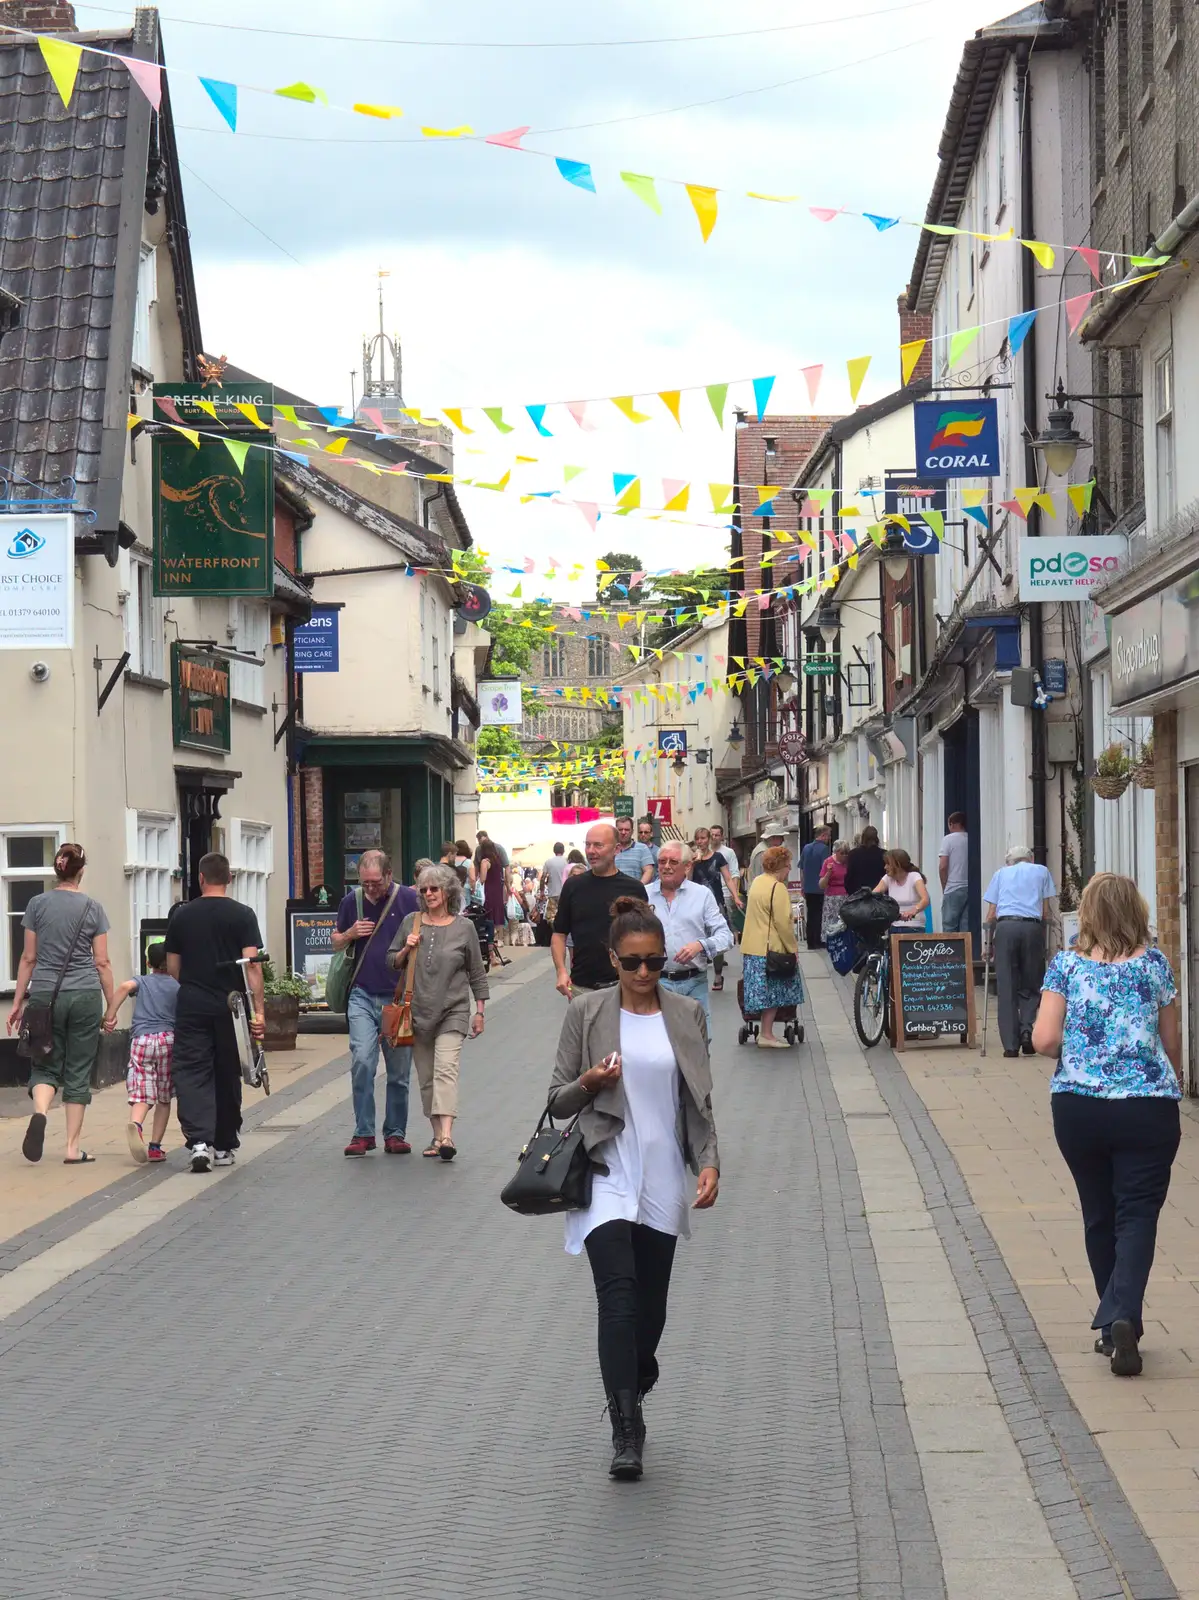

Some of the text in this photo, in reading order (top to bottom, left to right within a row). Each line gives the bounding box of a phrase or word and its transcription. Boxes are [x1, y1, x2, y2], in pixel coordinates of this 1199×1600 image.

[225, 395, 264, 406] KING
[925, 454, 990, 469] CORAL
[897, 497, 935, 513] HILL
[163, 557, 260, 569] WATERFRONT
[164, 572, 192, 583] INN
[1031, 579, 1050, 587] HELP
[1075, 578, 1095, 586] HELP
[8, 608, 32, 617] 01379
[32, 608, 61, 616] 640100
[313, 650, 333, 658] CARE
[1116, 628, 1160, 685] Superdrug
[783, 733, 804, 744] COSTA
[311, 928, 331, 937] 2 FOR
[305, 937, 332, 946] COCKTA
[906, 941, 955, 965] Sophies
